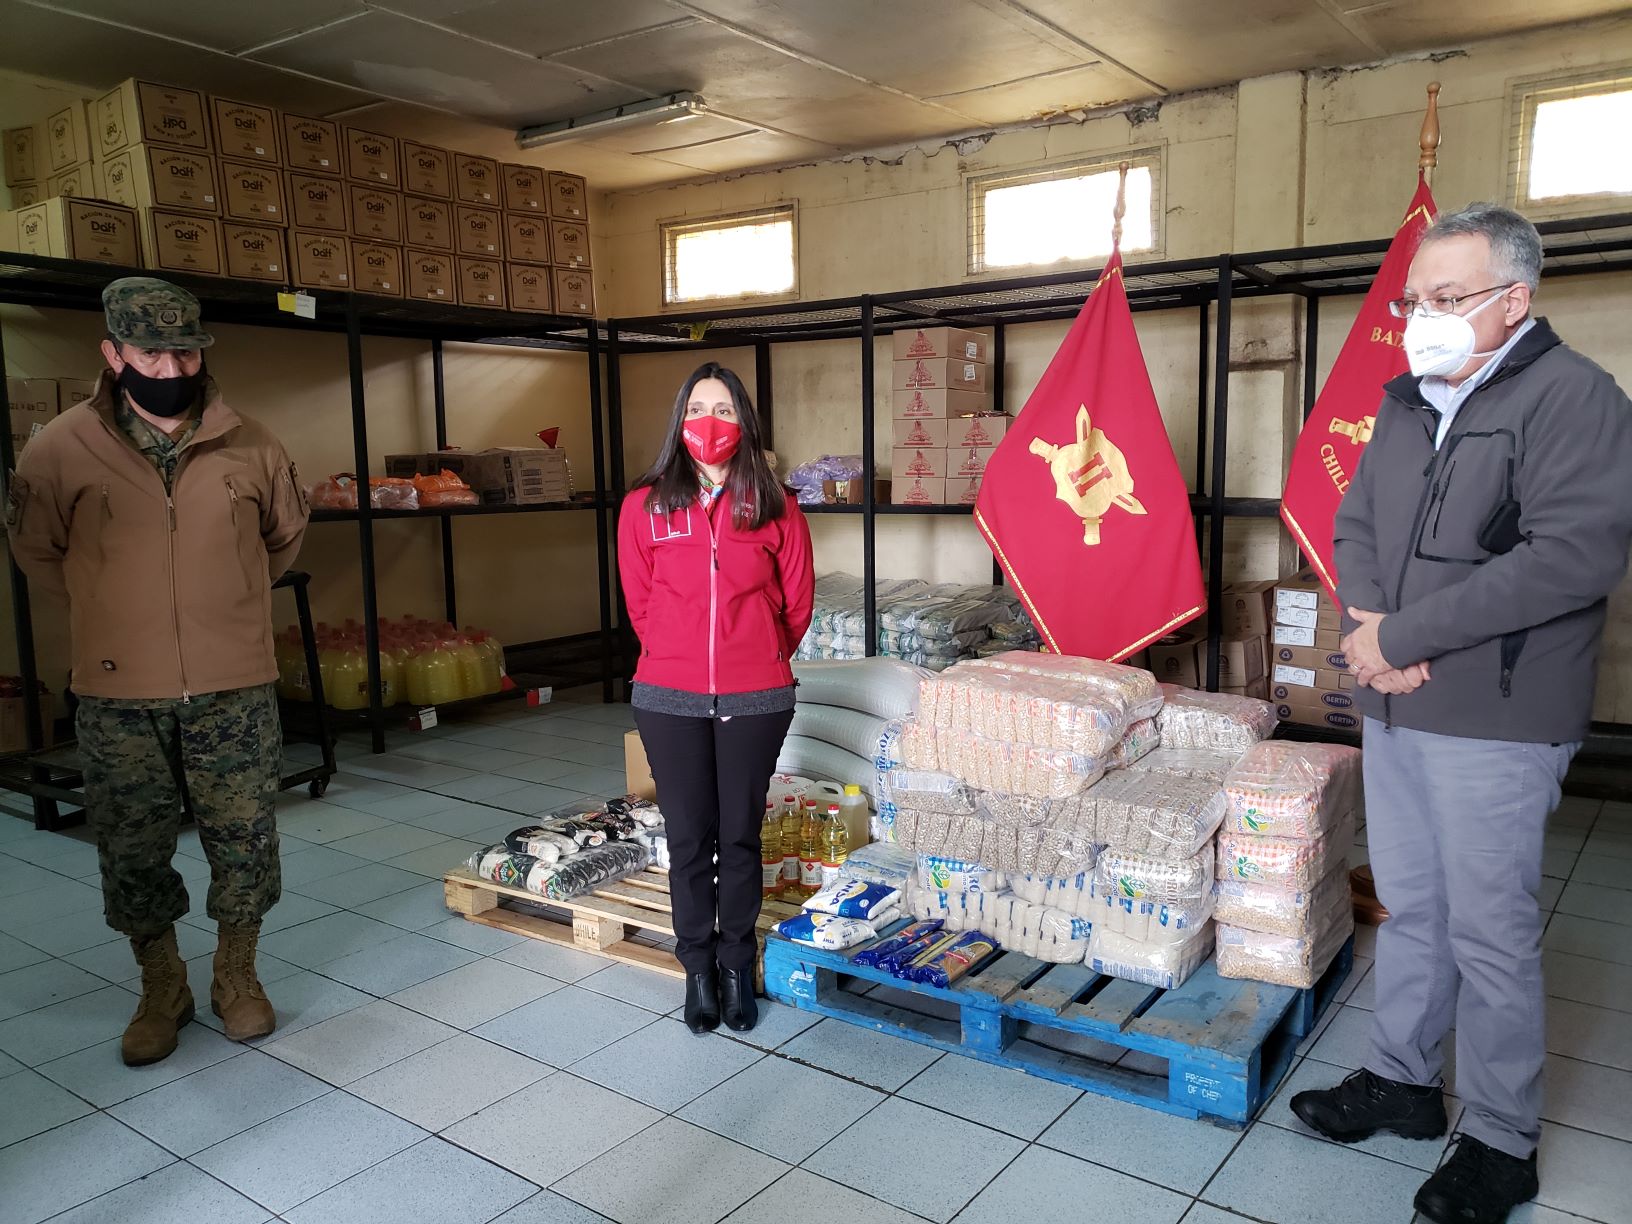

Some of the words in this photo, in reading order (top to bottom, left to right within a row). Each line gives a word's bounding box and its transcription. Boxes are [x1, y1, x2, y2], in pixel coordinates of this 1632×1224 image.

[1068, 451, 1113, 497] II
[1326, 695, 1352, 706] BERTIN
[1329, 714, 1355, 725] BERTIN
